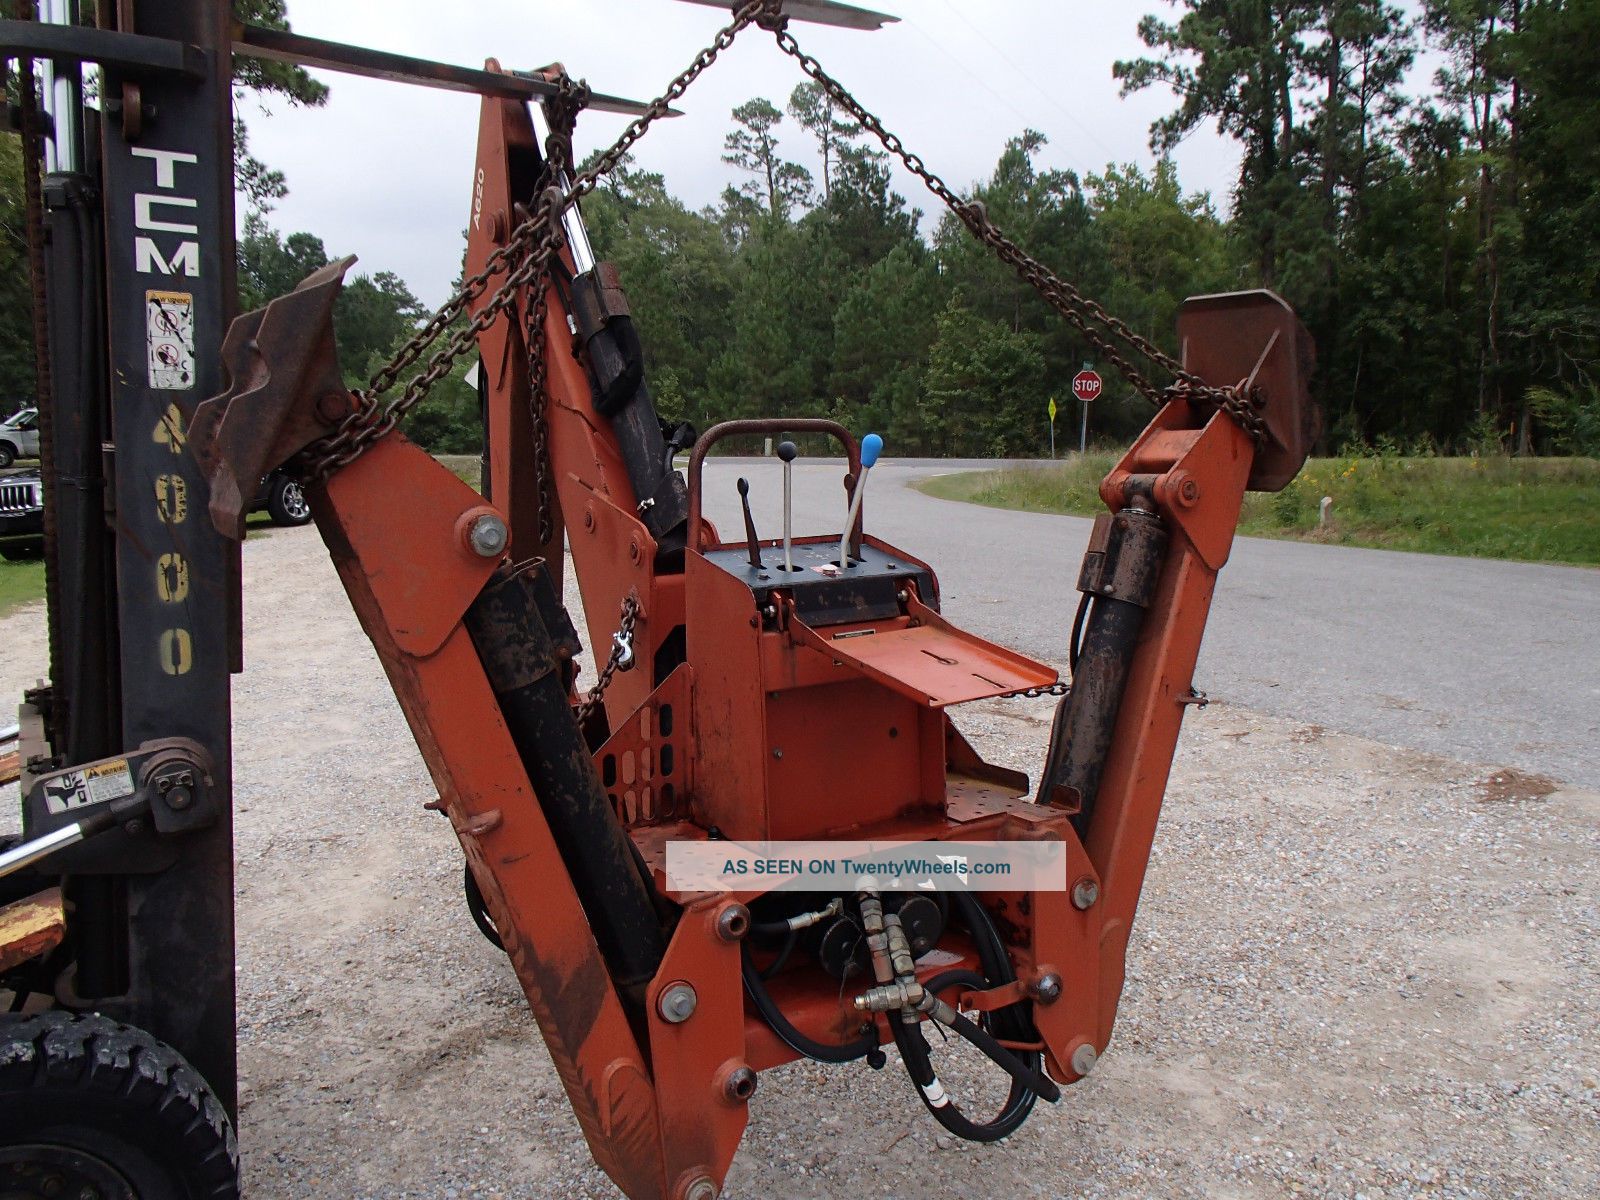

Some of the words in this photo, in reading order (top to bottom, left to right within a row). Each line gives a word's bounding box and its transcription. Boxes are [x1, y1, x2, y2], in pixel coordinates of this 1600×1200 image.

[131, 147, 200, 277] TCM
[473, 168, 485, 231] A620
[1074, 380, 1100, 392] STOP
[152, 402, 193, 676] 4000
